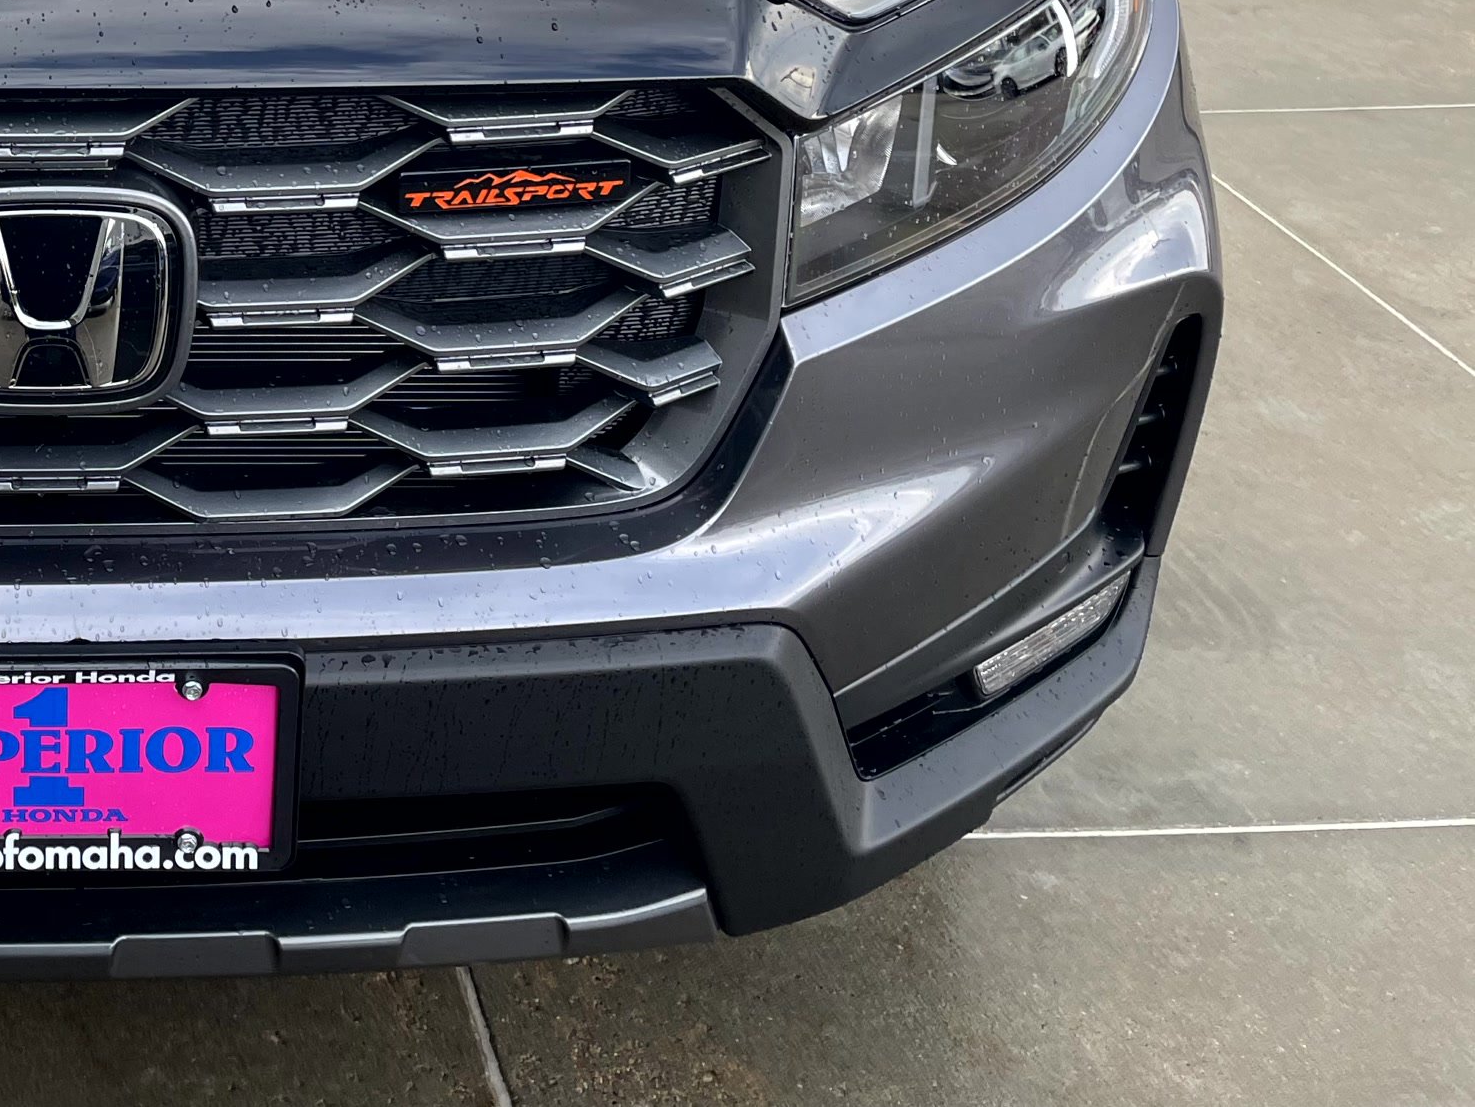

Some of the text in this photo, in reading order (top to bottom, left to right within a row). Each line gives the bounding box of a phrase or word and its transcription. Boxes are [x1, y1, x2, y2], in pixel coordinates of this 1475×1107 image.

[404, 179, 624, 210] TRAILSPORT
[75, 669, 176, 684] Honda
[1, 807, 129, 824] HONDA
